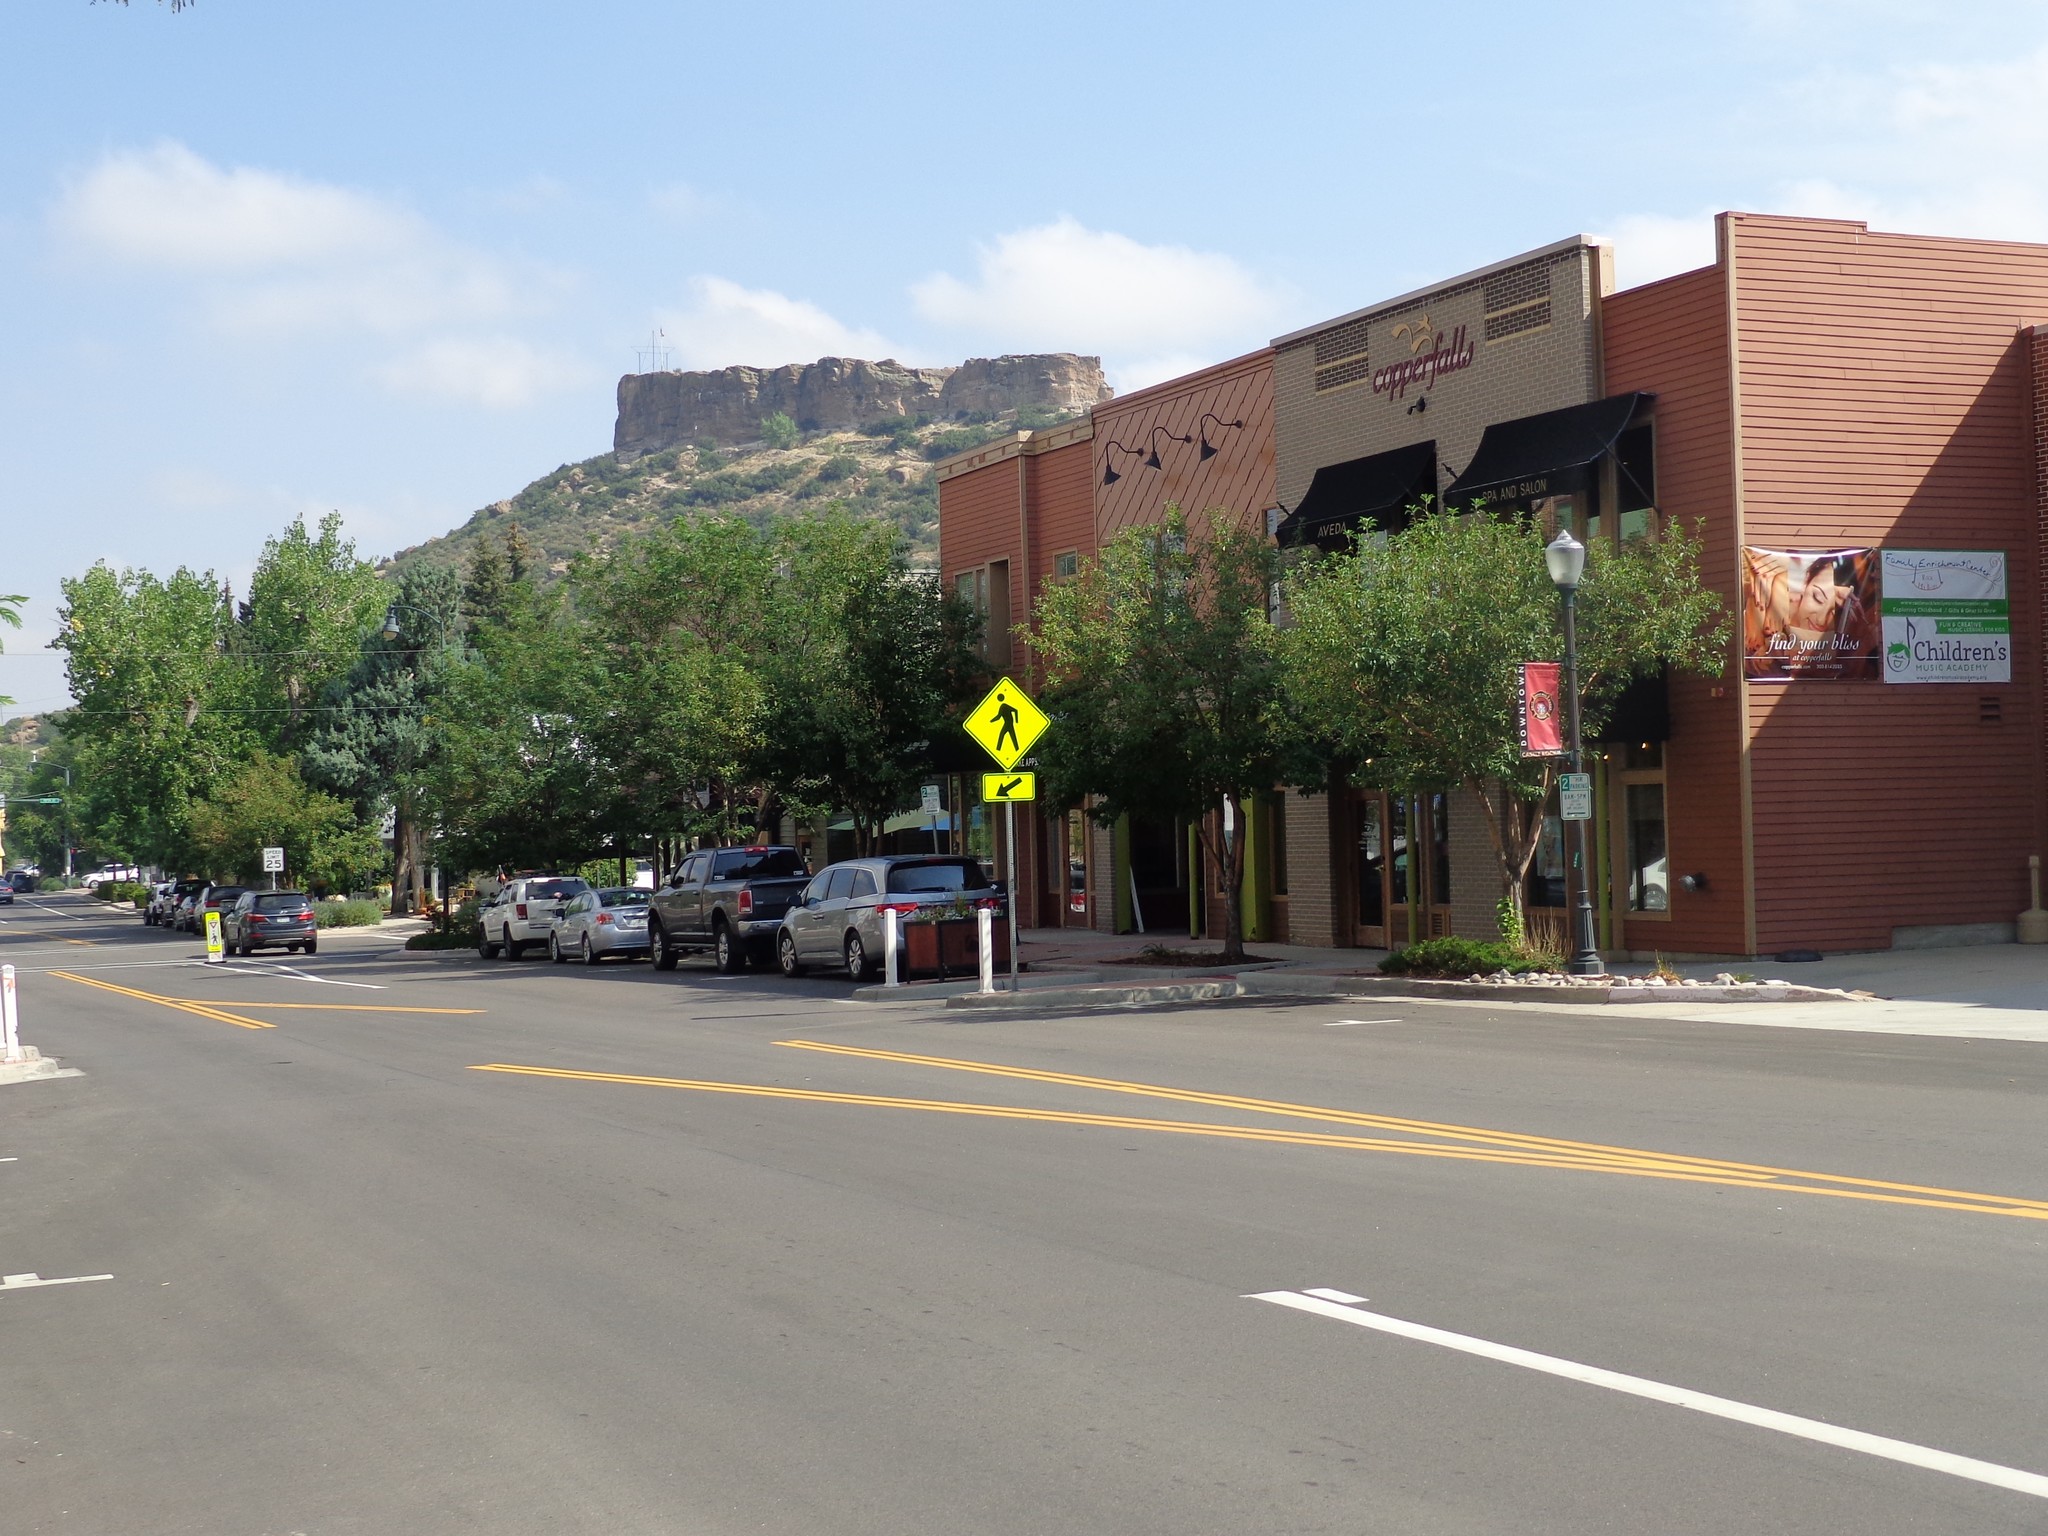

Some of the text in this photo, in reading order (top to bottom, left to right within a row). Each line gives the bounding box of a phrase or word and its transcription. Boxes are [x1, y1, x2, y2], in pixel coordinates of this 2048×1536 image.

[1372, 323, 1475, 402] copperfalls
[1481, 478, 1547, 504] SPA AND SALON
[1316, 521, 1347, 539] AVEDA
[1885, 552, 1991, 578] Family Enrichment Center
[1765, 633, 1860, 655] find your bliss
[1914, 640, 2007, 662] Children's
[1800, 652, 1832, 663] copperfalls
[1915, 663, 1988, 672] MUSIC ACADEMY
[1519, 665, 1528, 747] DOWNTOWN
[1562, 777, 1569, 790] 2
[265, 859, 282, 869] 25
